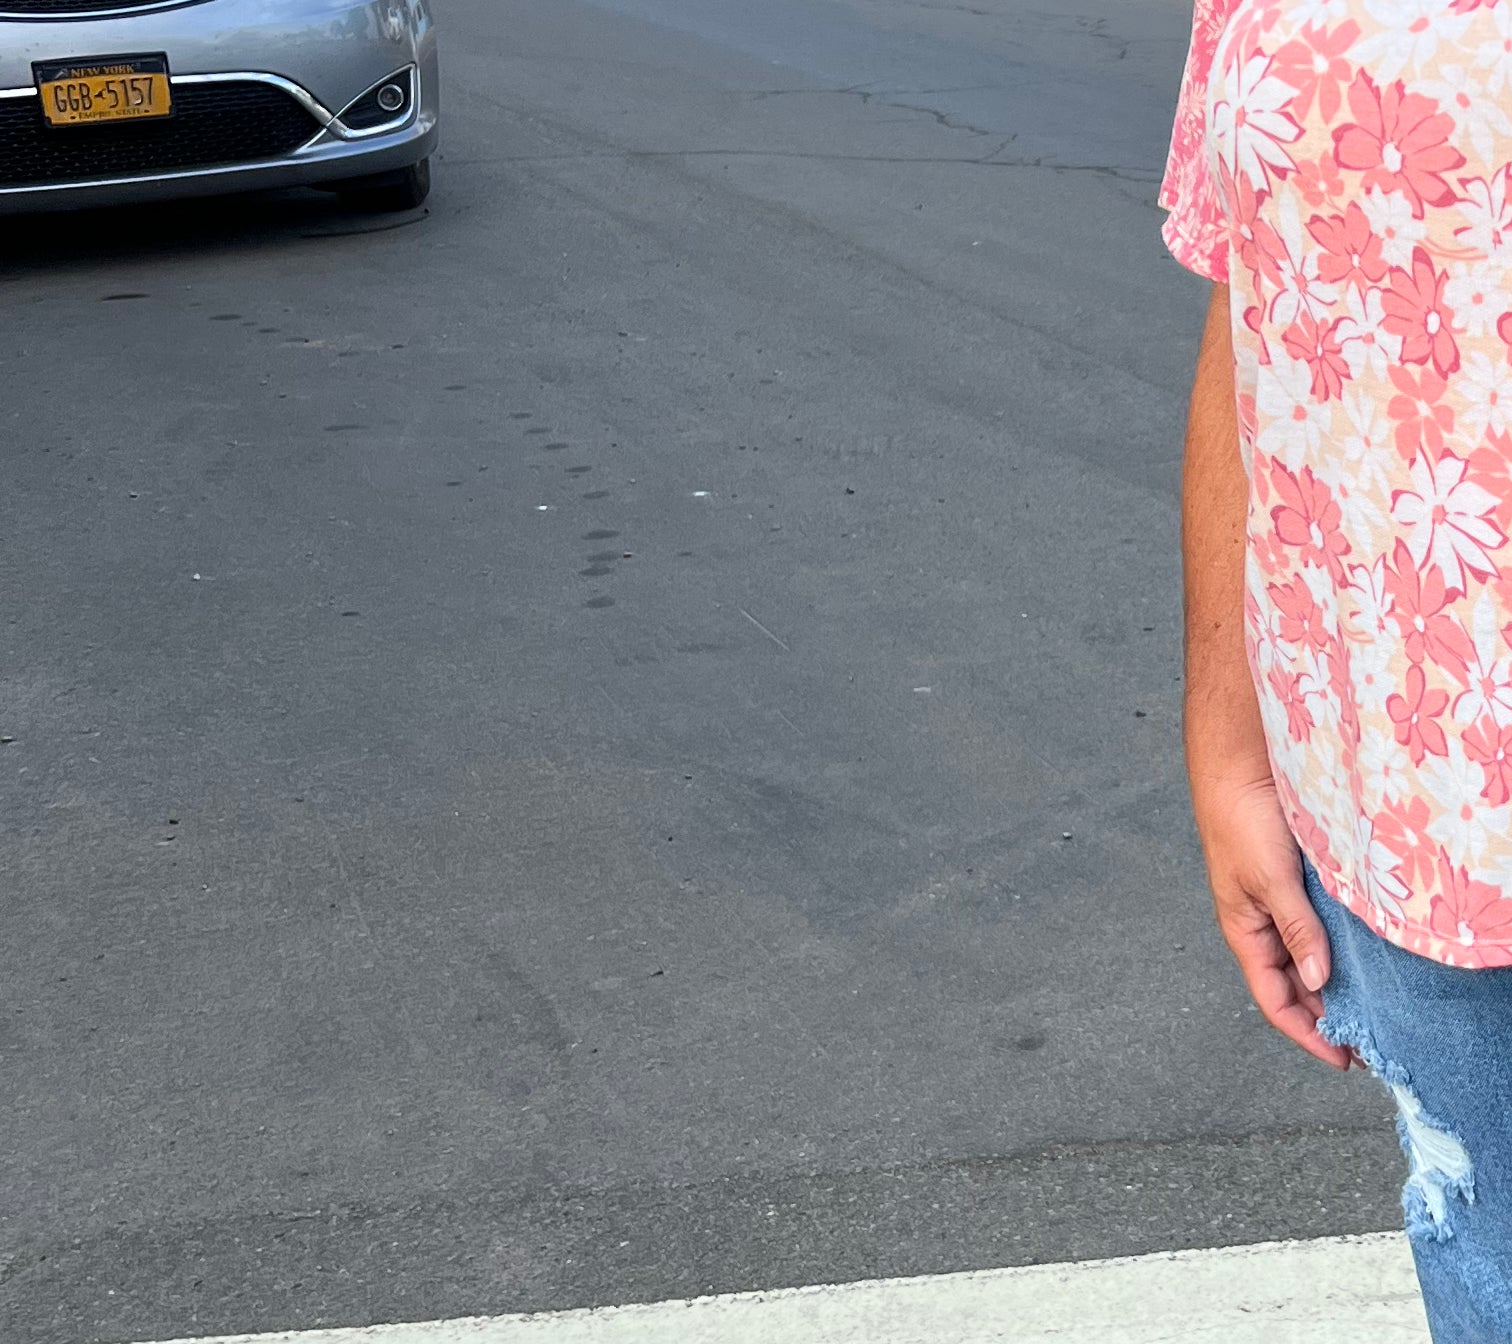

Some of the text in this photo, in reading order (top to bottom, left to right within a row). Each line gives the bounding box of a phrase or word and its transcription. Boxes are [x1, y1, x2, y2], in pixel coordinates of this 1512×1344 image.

[71, 64, 135, 78] NEW YORK
[54, 77, 153, 113] GGB 5157
